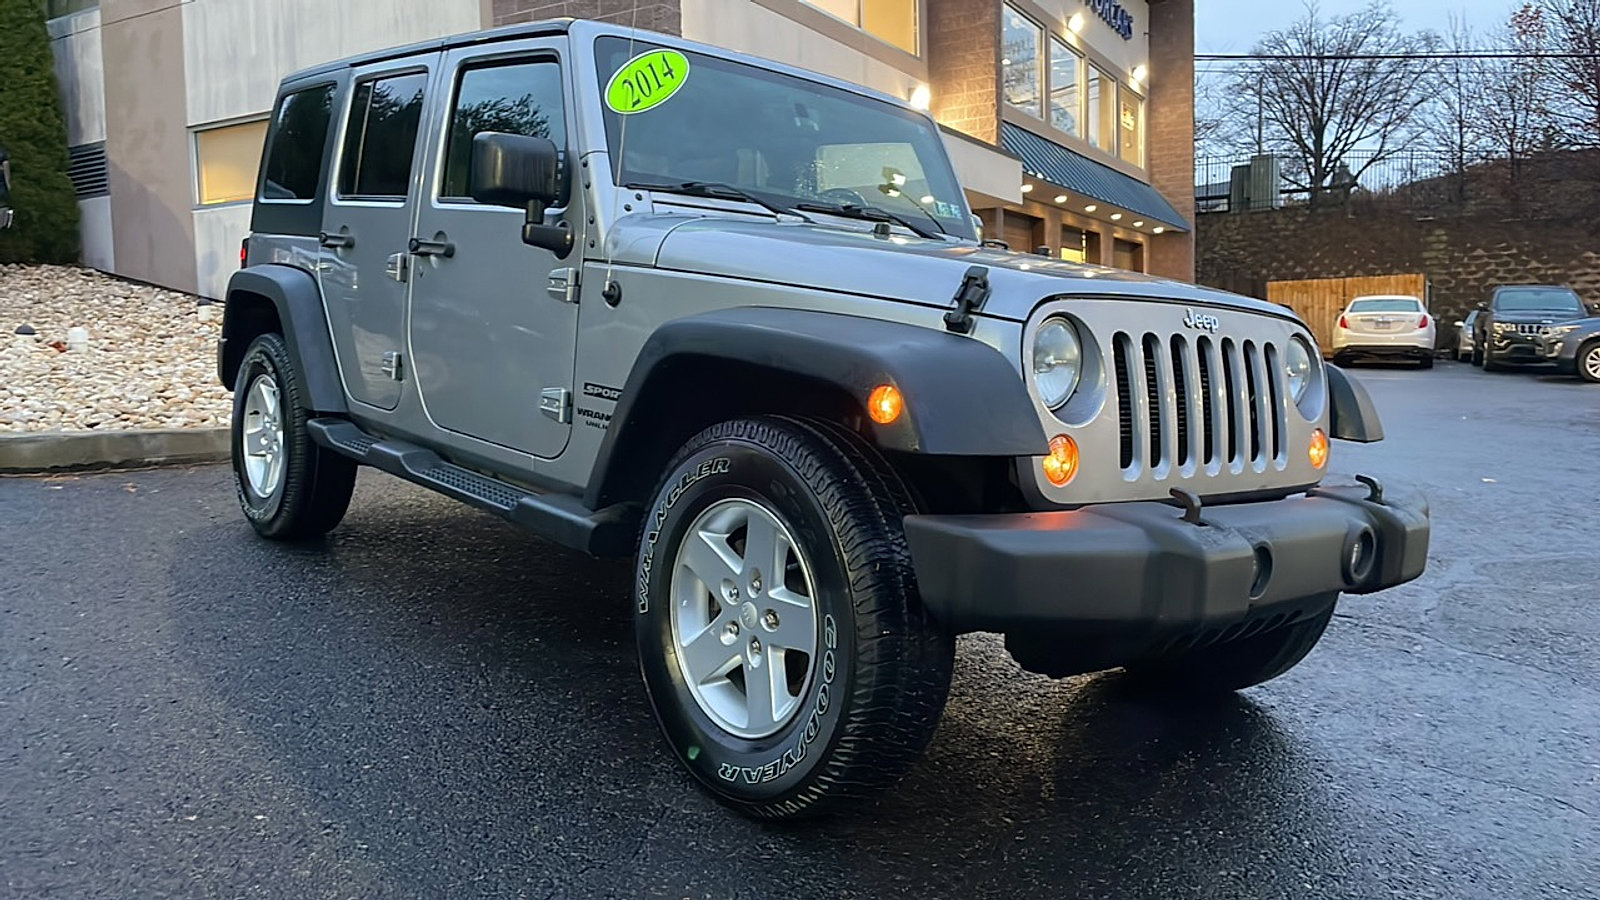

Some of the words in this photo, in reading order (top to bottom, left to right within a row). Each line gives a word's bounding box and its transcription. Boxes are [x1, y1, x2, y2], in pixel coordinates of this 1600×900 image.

[622, 54, 675, 108] 2014
[1183, 307, 1219, 334] Jeep
[639, 457, 731, 614] WRANGLER
[717, 614, 838, 784] GOODYEAR
